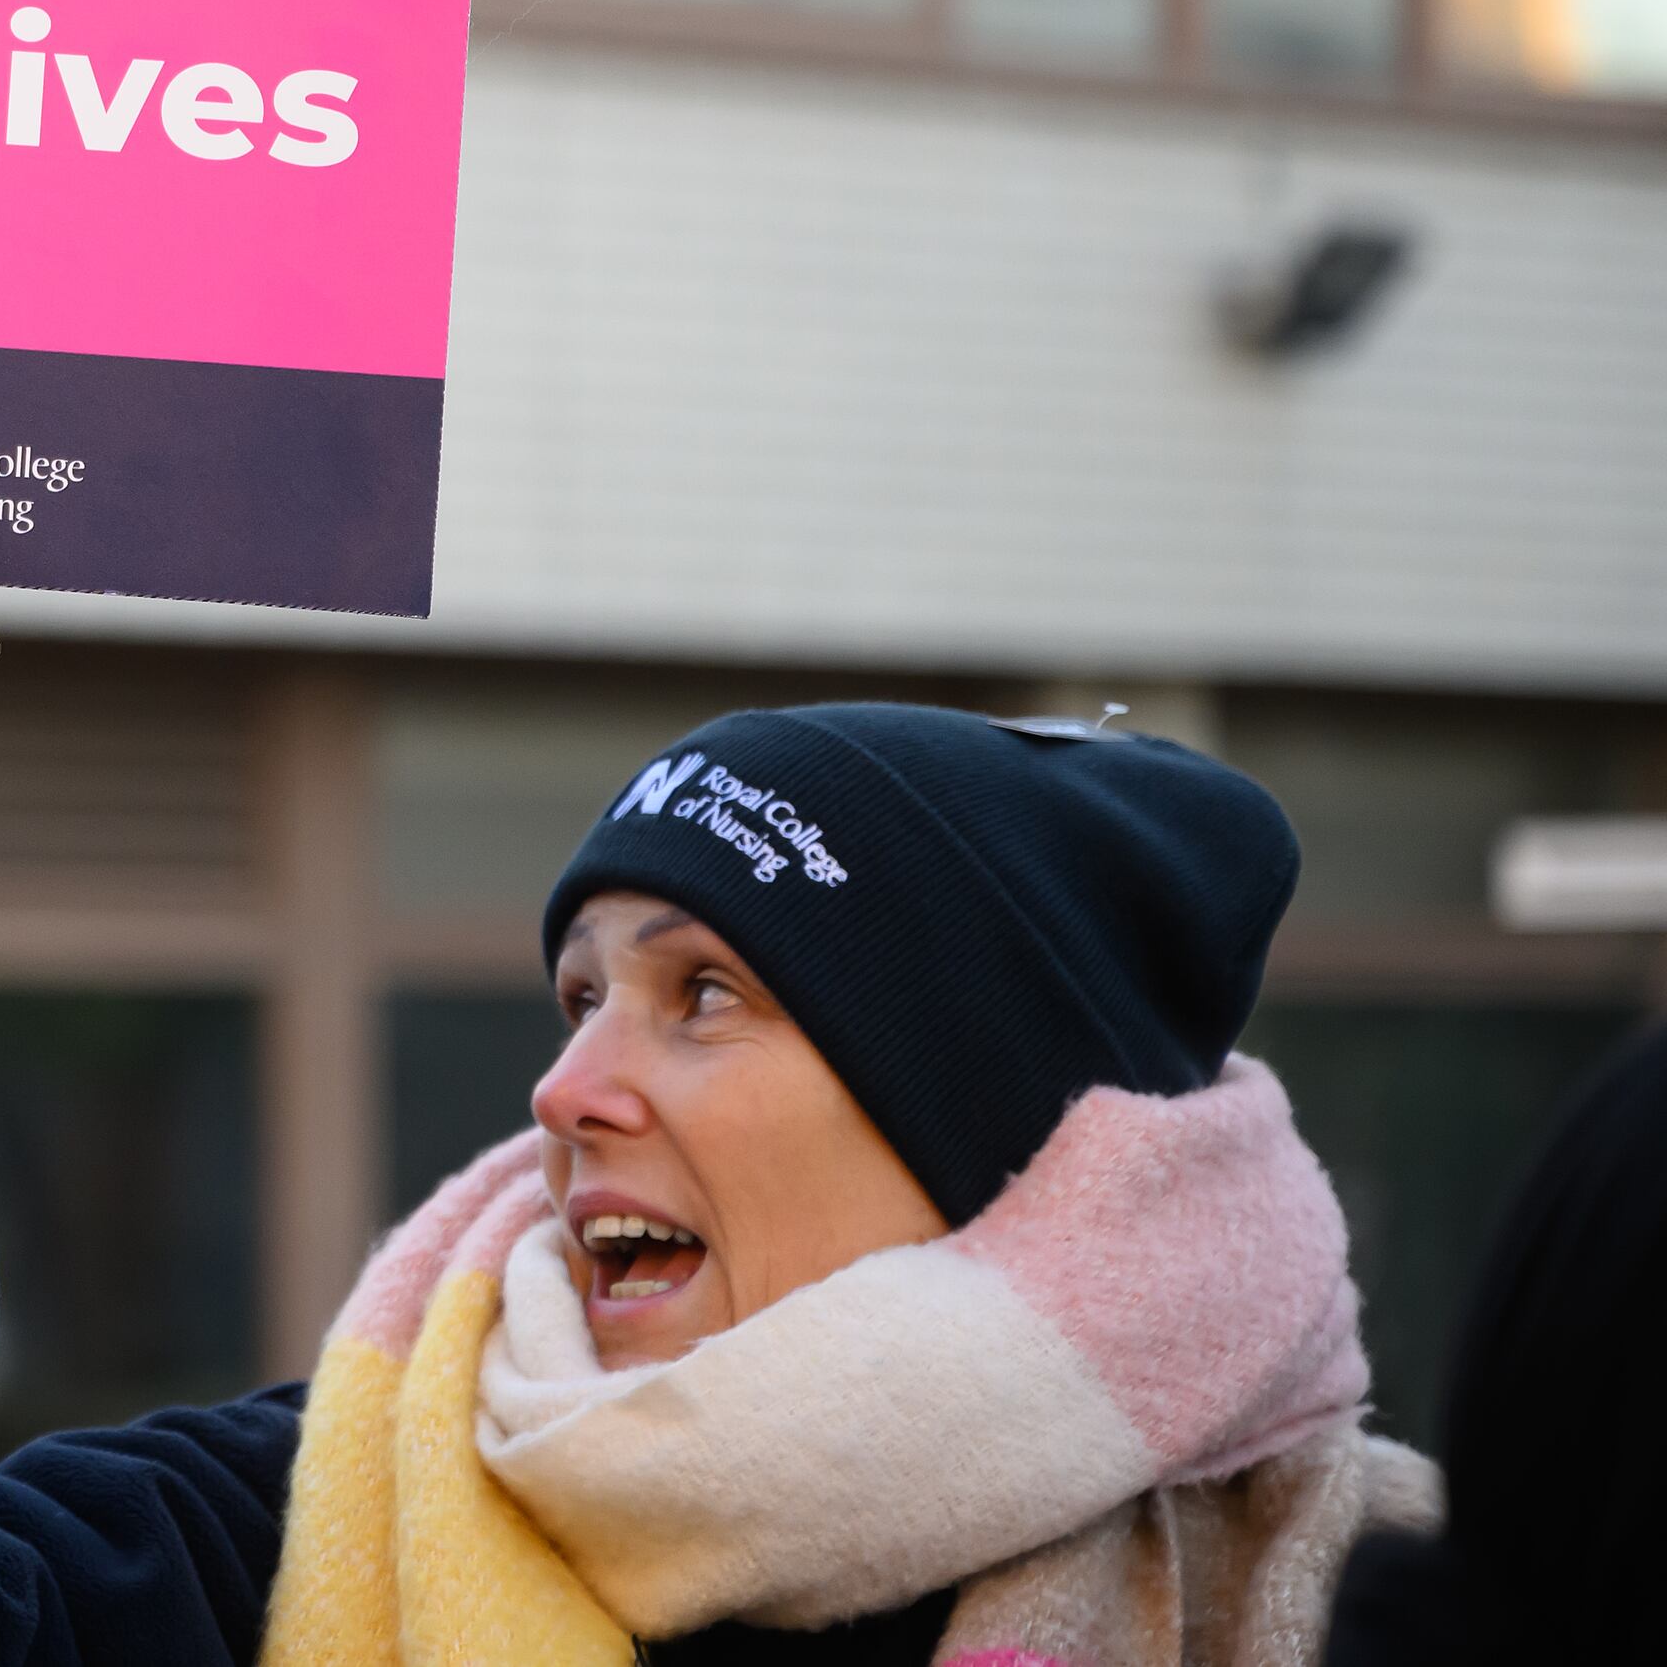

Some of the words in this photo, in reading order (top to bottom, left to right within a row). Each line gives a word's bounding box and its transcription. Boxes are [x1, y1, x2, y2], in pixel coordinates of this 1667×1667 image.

[673, 796, 713, 819] of
[696, 807, 789, 883] Nursing
[699, 765, 775, 812] Royal
[765, 800, 848, 887] College
